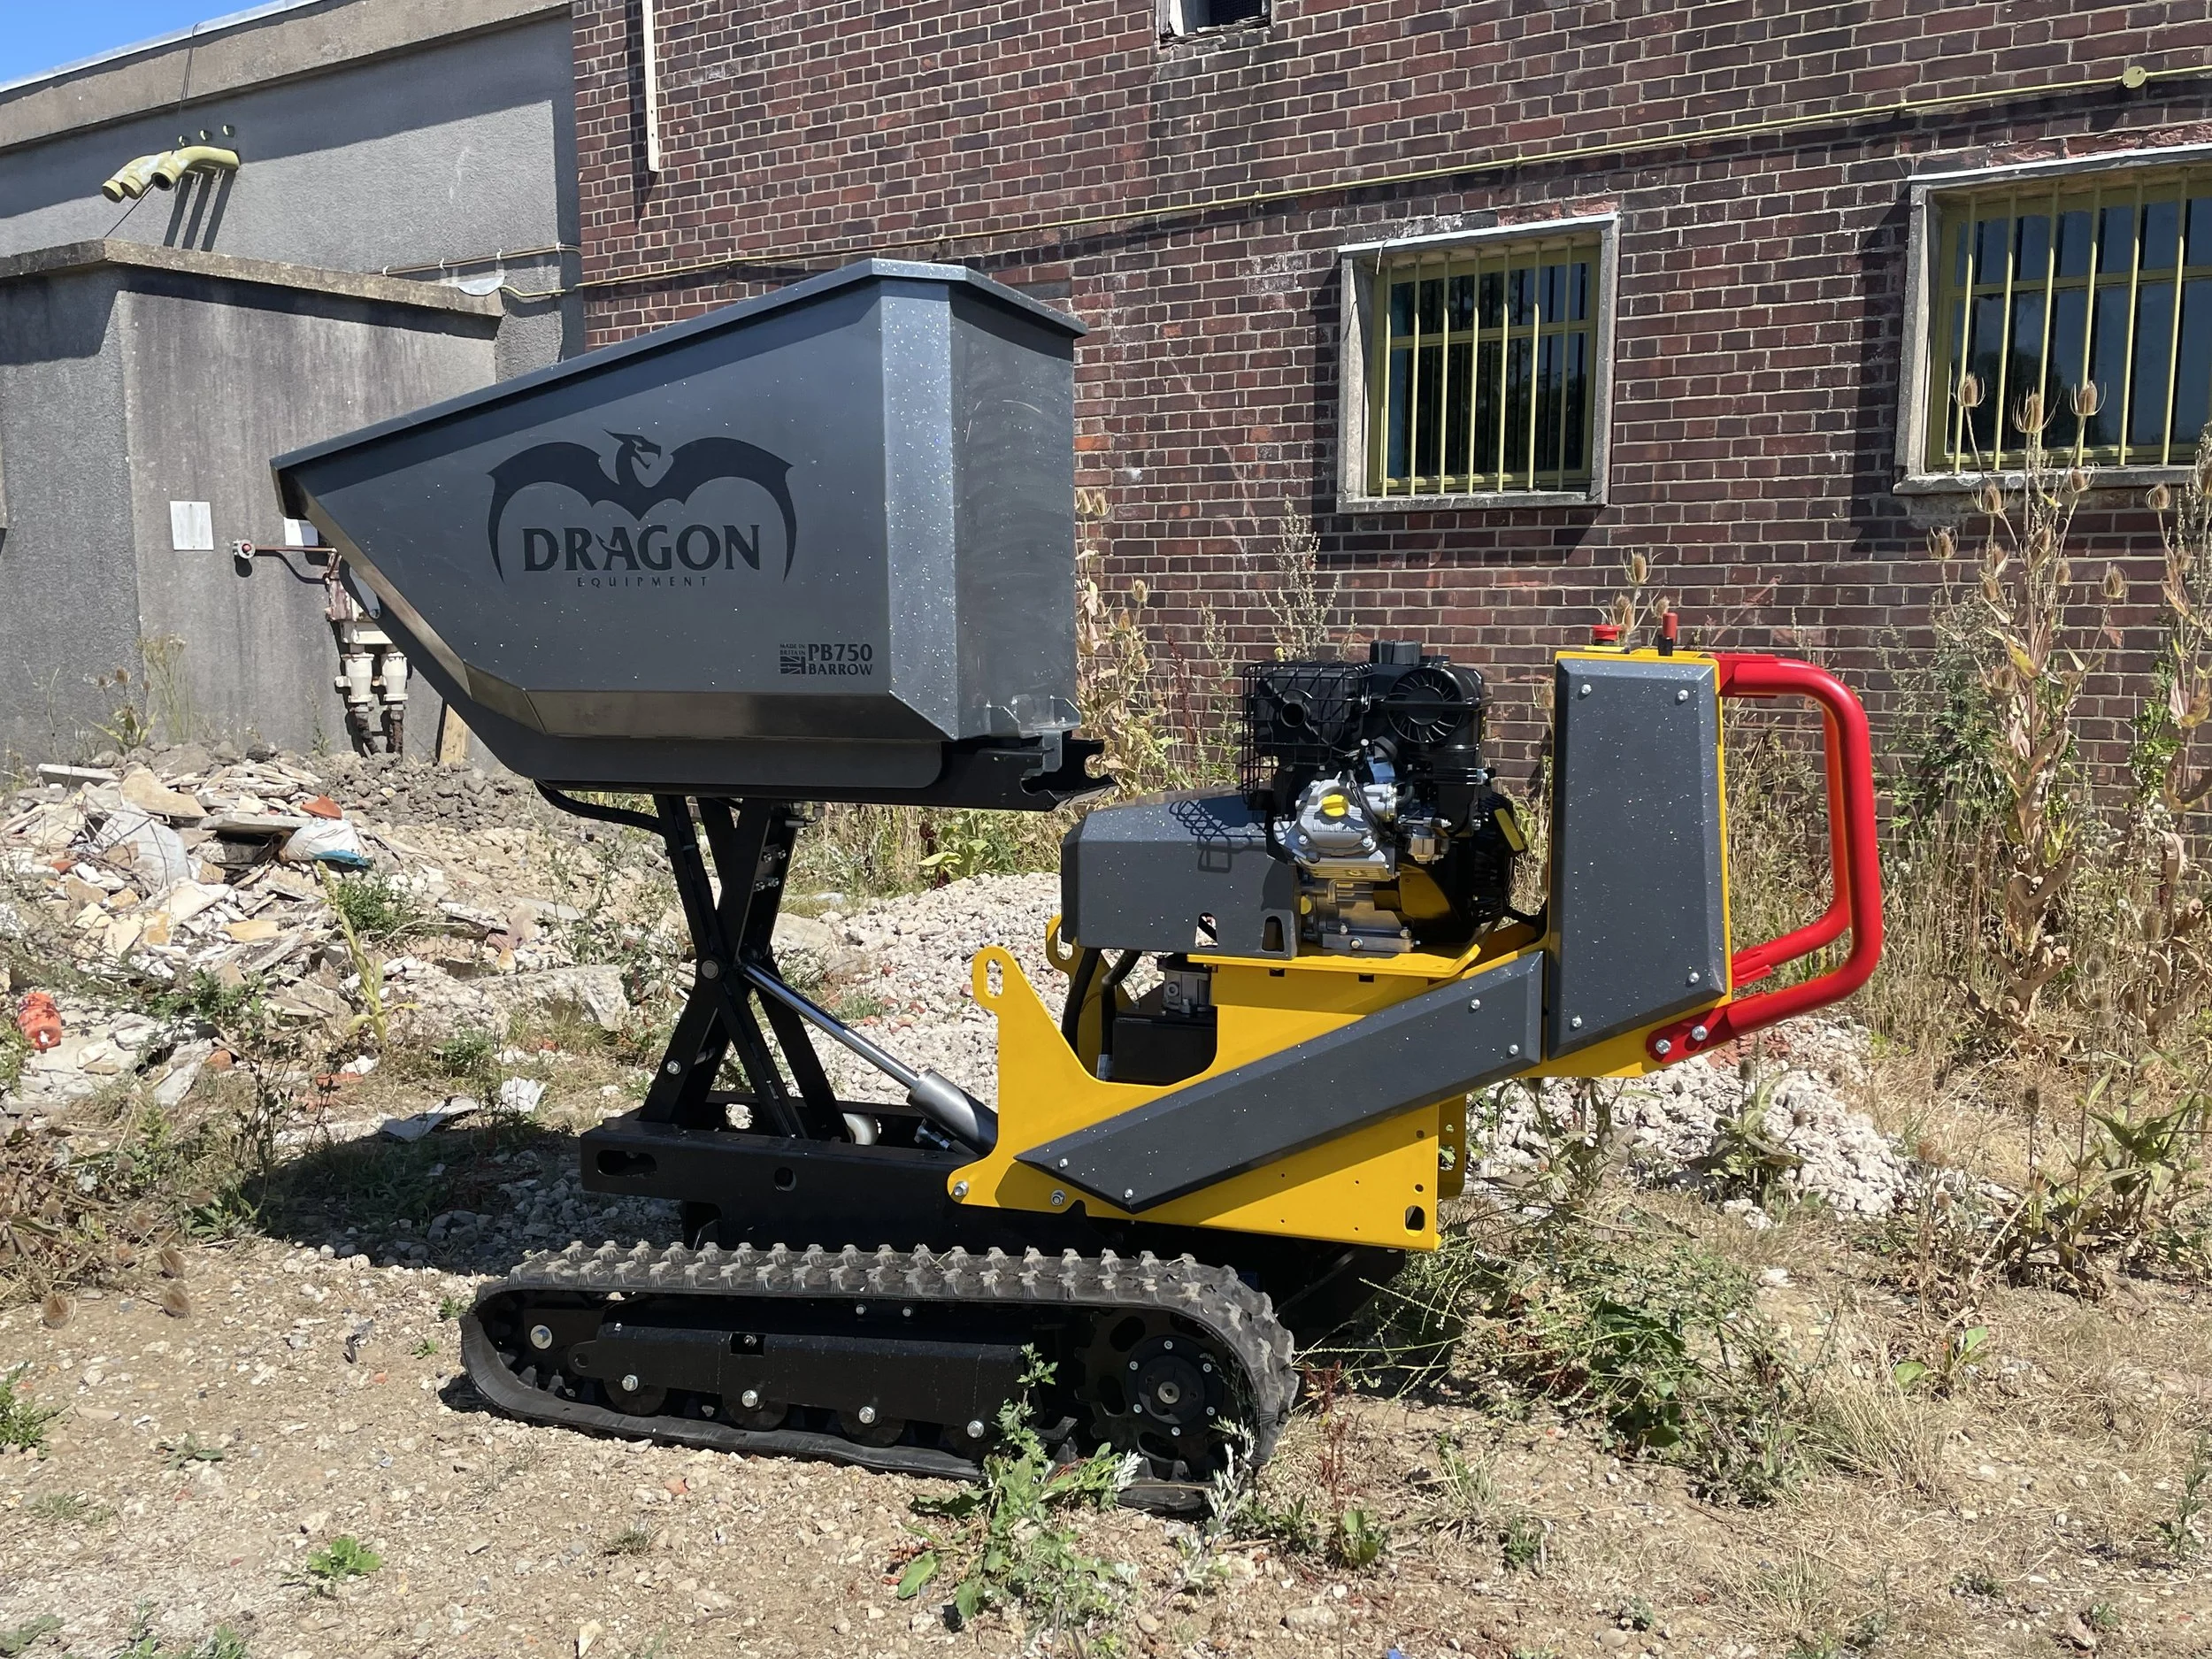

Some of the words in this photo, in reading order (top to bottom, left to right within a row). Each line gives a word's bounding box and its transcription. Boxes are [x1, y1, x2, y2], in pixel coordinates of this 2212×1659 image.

[522, 525, 760, 572] DRAGON
[577, 576, 708, 588] EQUIPMENT
[808, 643, 872, 662] PB750
[808, 663, 873, 676] BARROW
